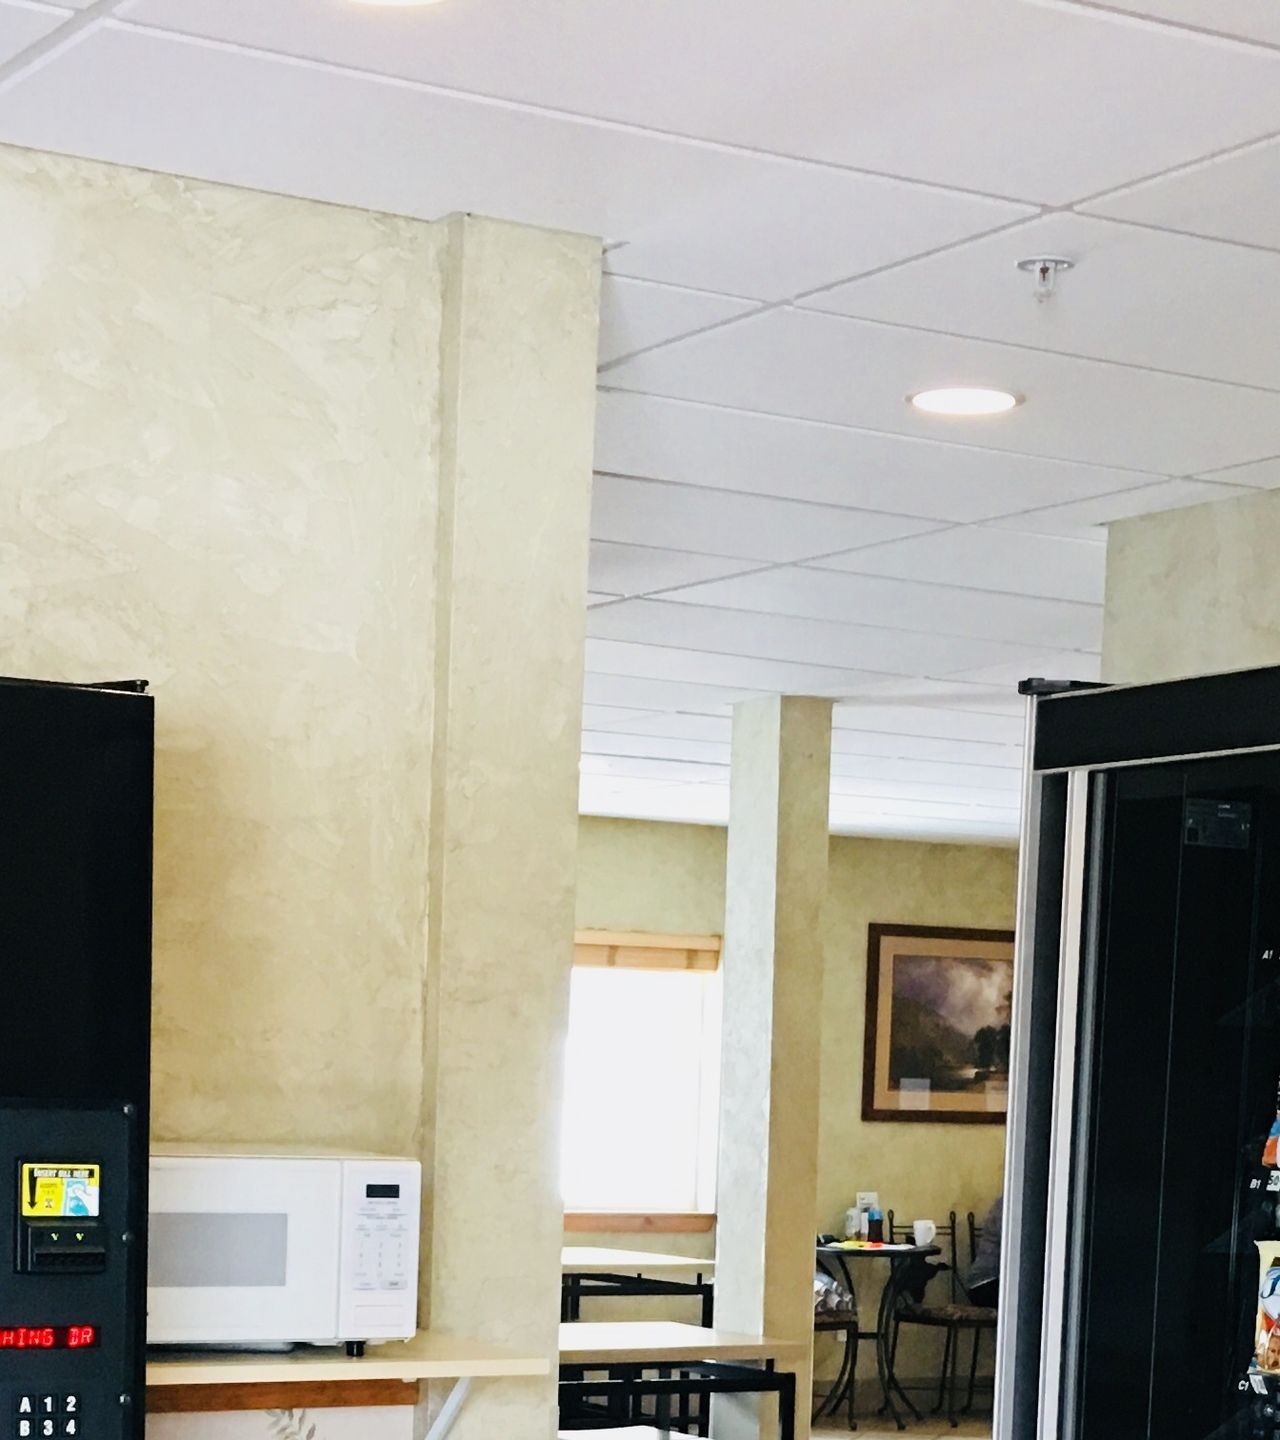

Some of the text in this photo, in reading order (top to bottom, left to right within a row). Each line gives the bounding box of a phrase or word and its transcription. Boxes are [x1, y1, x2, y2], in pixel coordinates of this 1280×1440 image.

[20, 1396, 76, 1412] A 1 2
[20, 1420, 76, 1436] B 3 4
